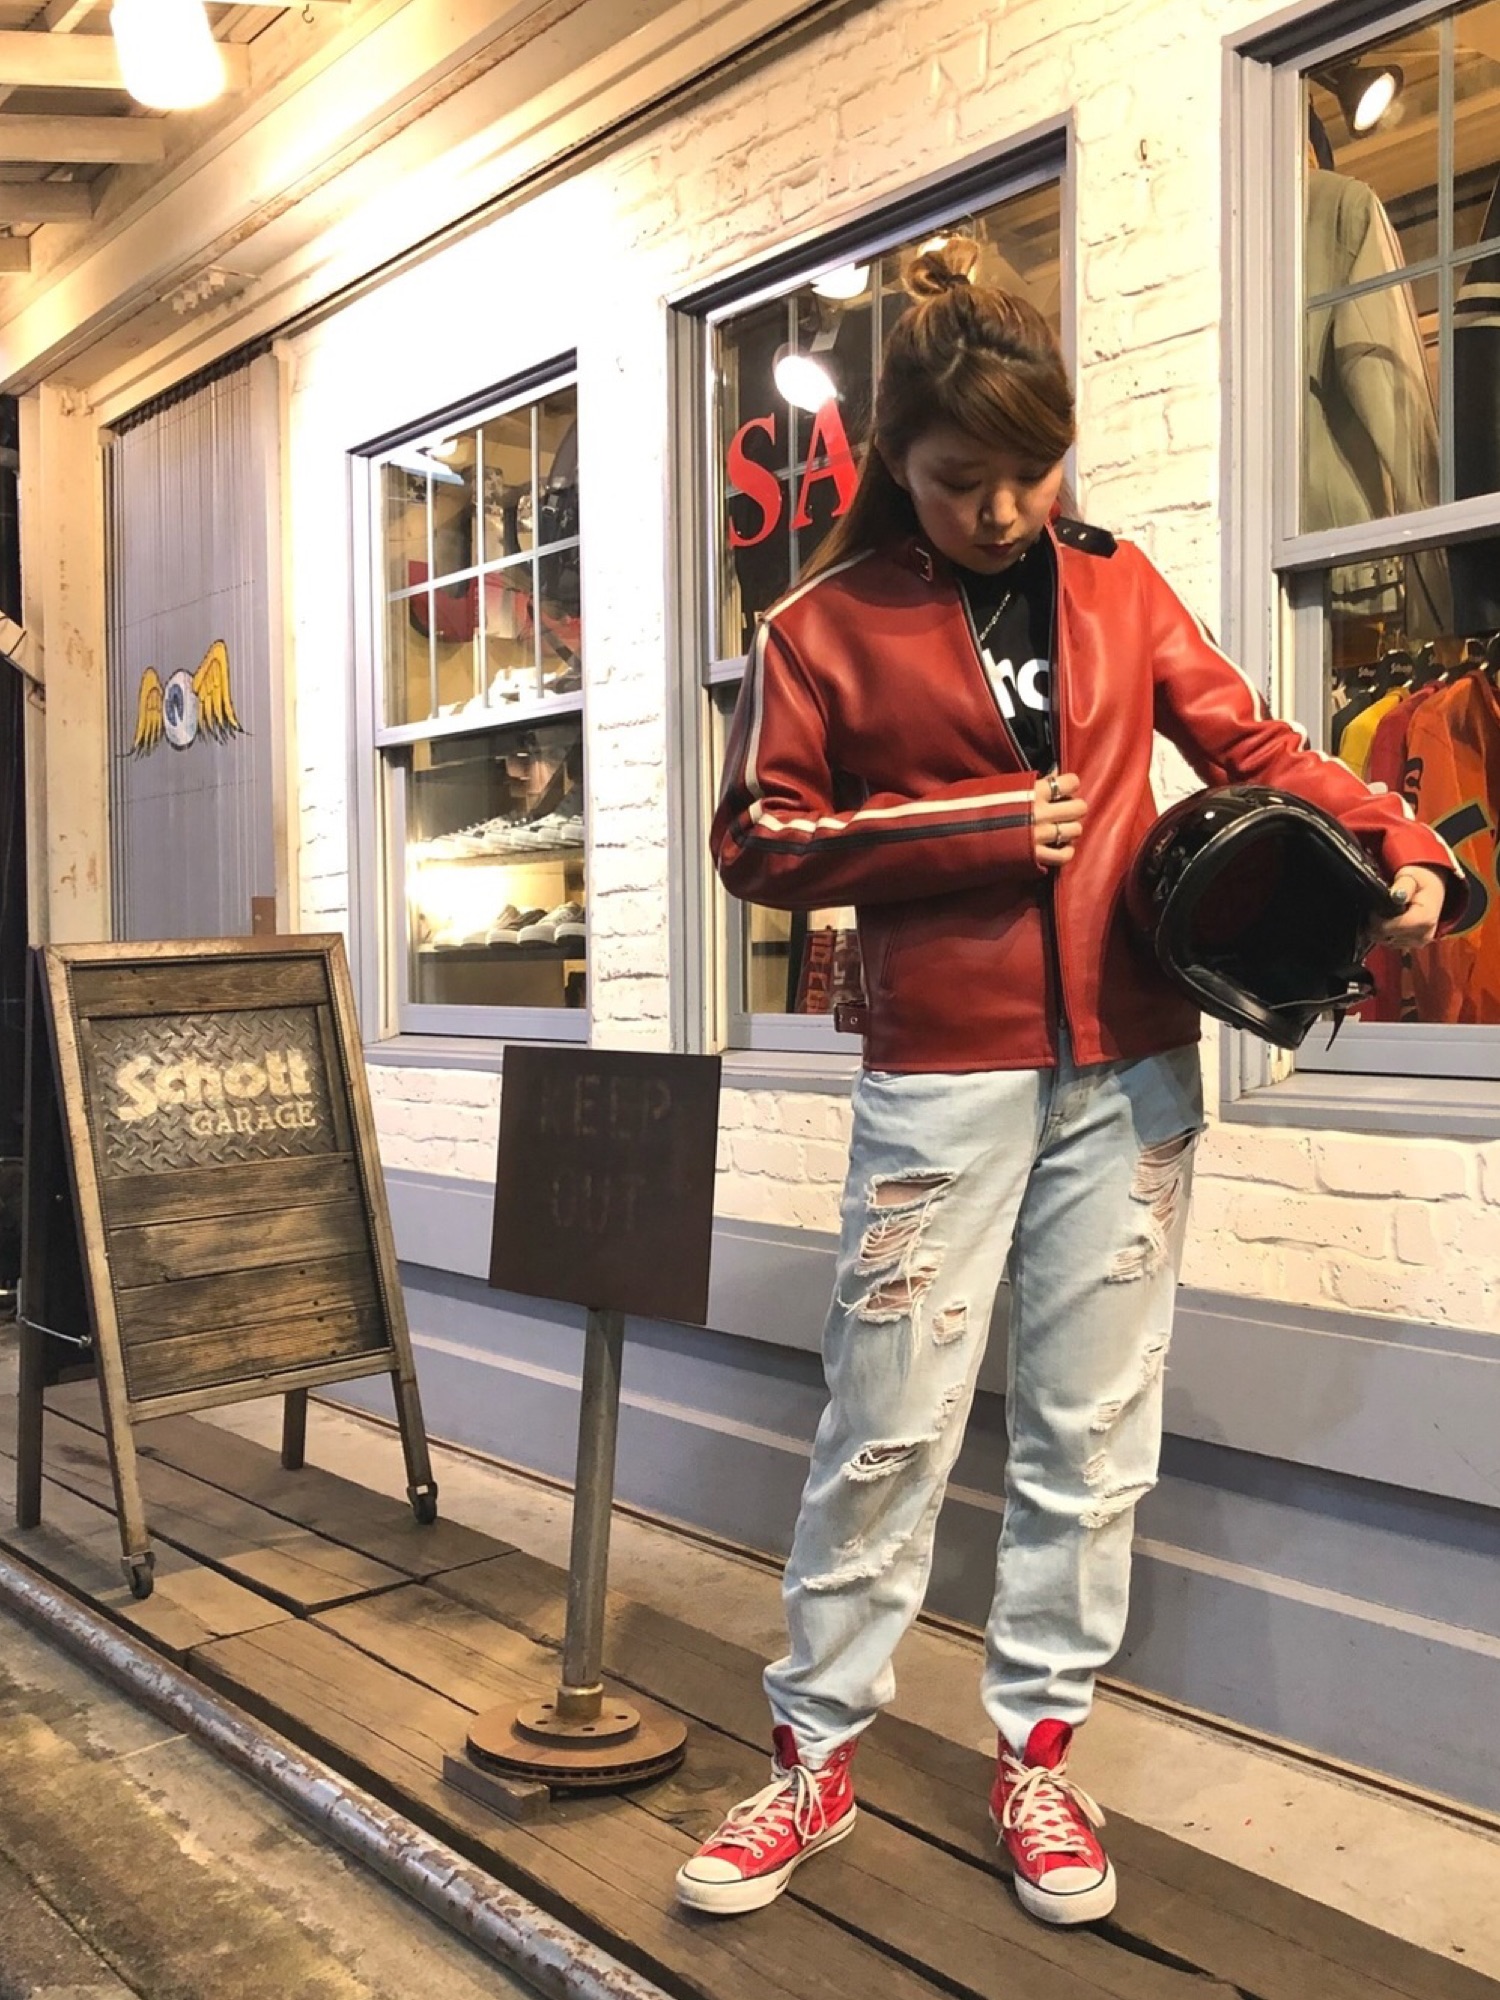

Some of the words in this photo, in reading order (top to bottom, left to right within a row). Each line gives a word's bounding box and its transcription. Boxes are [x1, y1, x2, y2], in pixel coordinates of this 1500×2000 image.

[726, 398, 858, 549] SA
[117, 1048, 312, 1121] Schott
[191, 1101, 316, 1136] GARAGE
